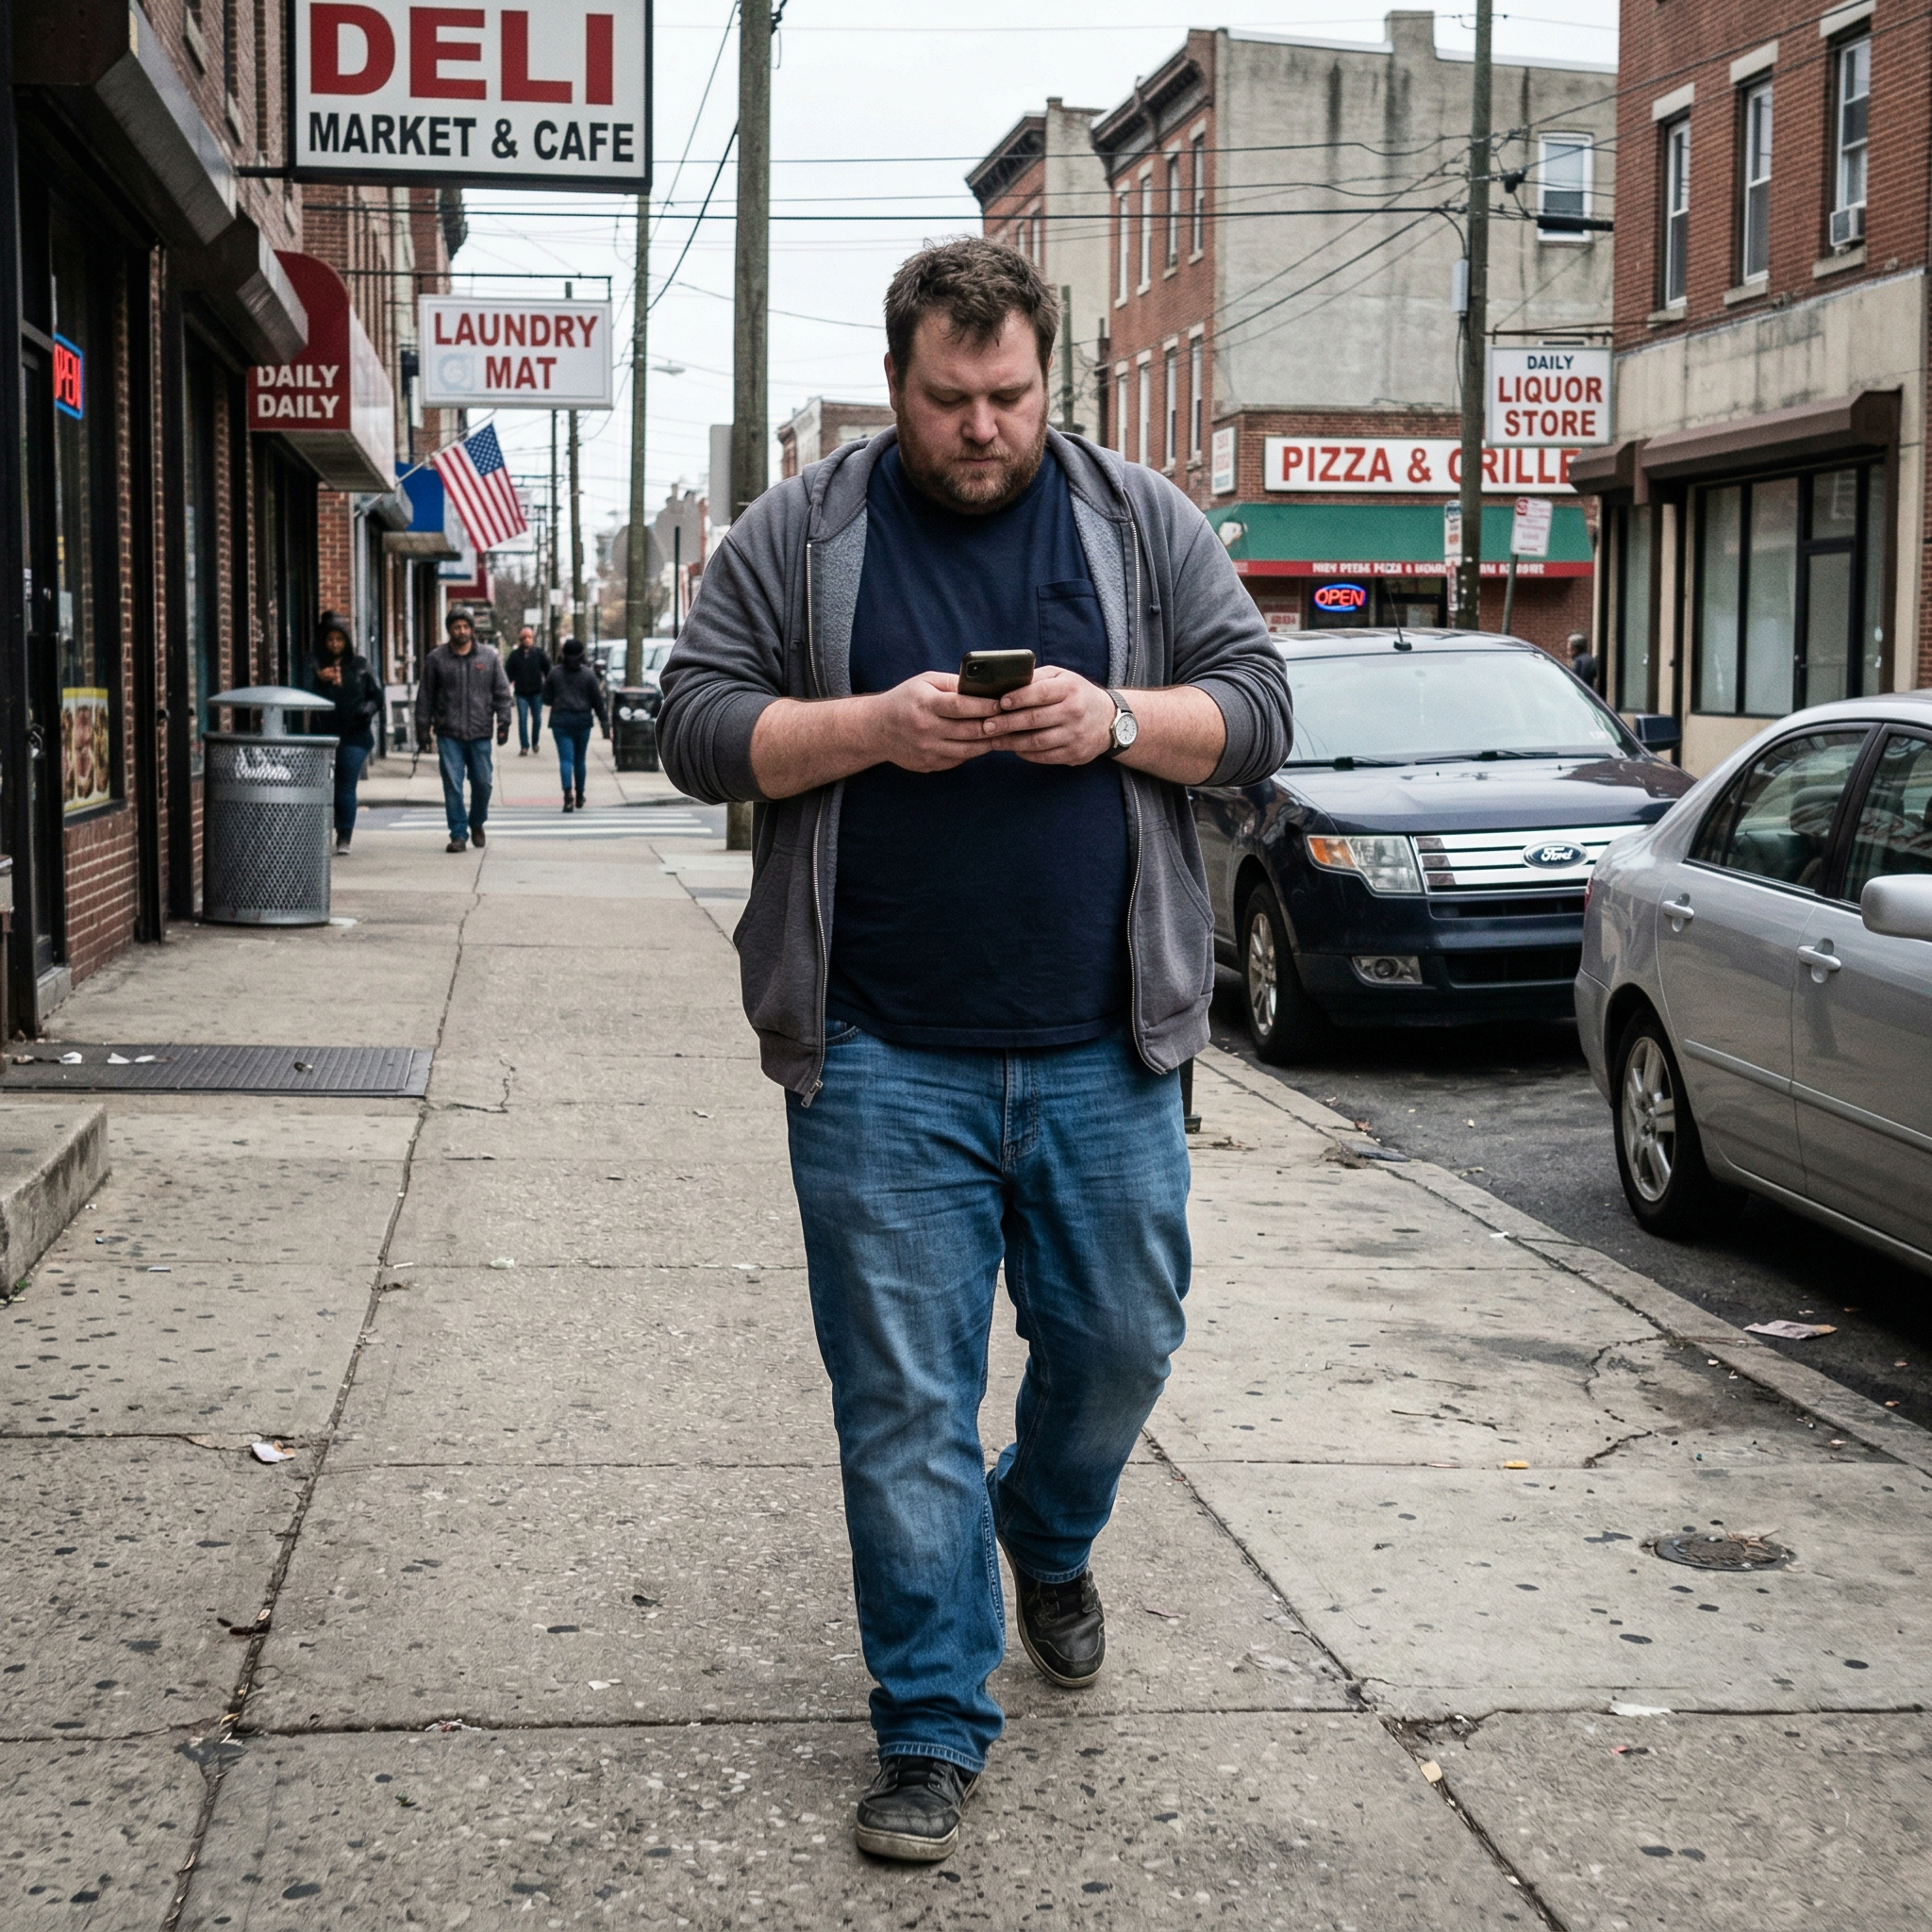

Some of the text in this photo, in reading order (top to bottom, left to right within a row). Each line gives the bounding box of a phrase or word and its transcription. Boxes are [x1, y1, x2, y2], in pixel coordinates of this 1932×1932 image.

[309, 2, 614, 106] DELI
[308, 111, 634, 163] MARKET & CAFE
[435, 312, 598, 347] LAUNDRY
[257, 364, 340, 388] DAILY
[486, 356, 558, 390] MAT
[1526, 355, 1574, 370] DAILY
[1498, 376, 1603, 404] LIQUOR
[258, 393, 341, 419] DAILY
[1505, 409, 1596, 437] STORE
[1282, 446, 1392, 482] PIZZA
[1407, 447, 1433, 484] &
[1314, 589, 1366, 606] OPEN
[1541, 846, 1574, 861] Ford
